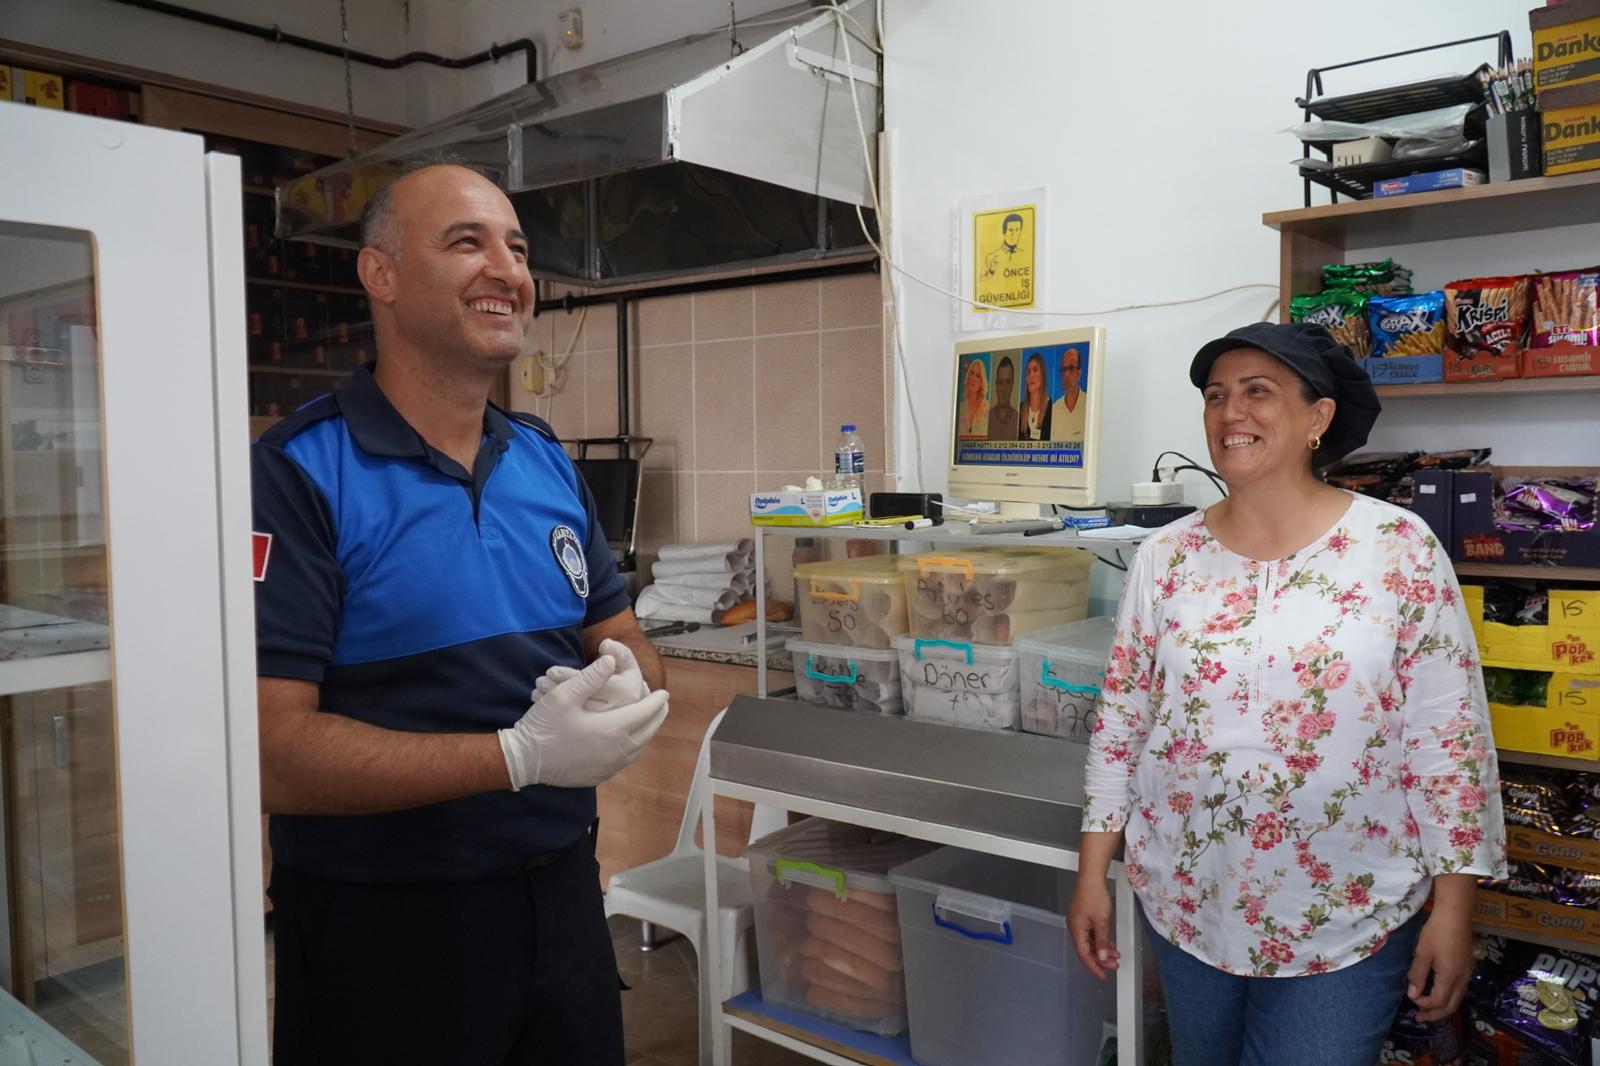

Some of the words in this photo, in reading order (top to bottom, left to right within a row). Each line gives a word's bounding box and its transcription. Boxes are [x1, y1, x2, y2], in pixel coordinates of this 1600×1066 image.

[1561, 600, 1587, 619] 15
[924, 662, 992, 690] Döner
[1558, 691, 1588, 706] 15
[1535, 842, 1583, 859] Gong
[1537, 911, 1585, 931] Gong
